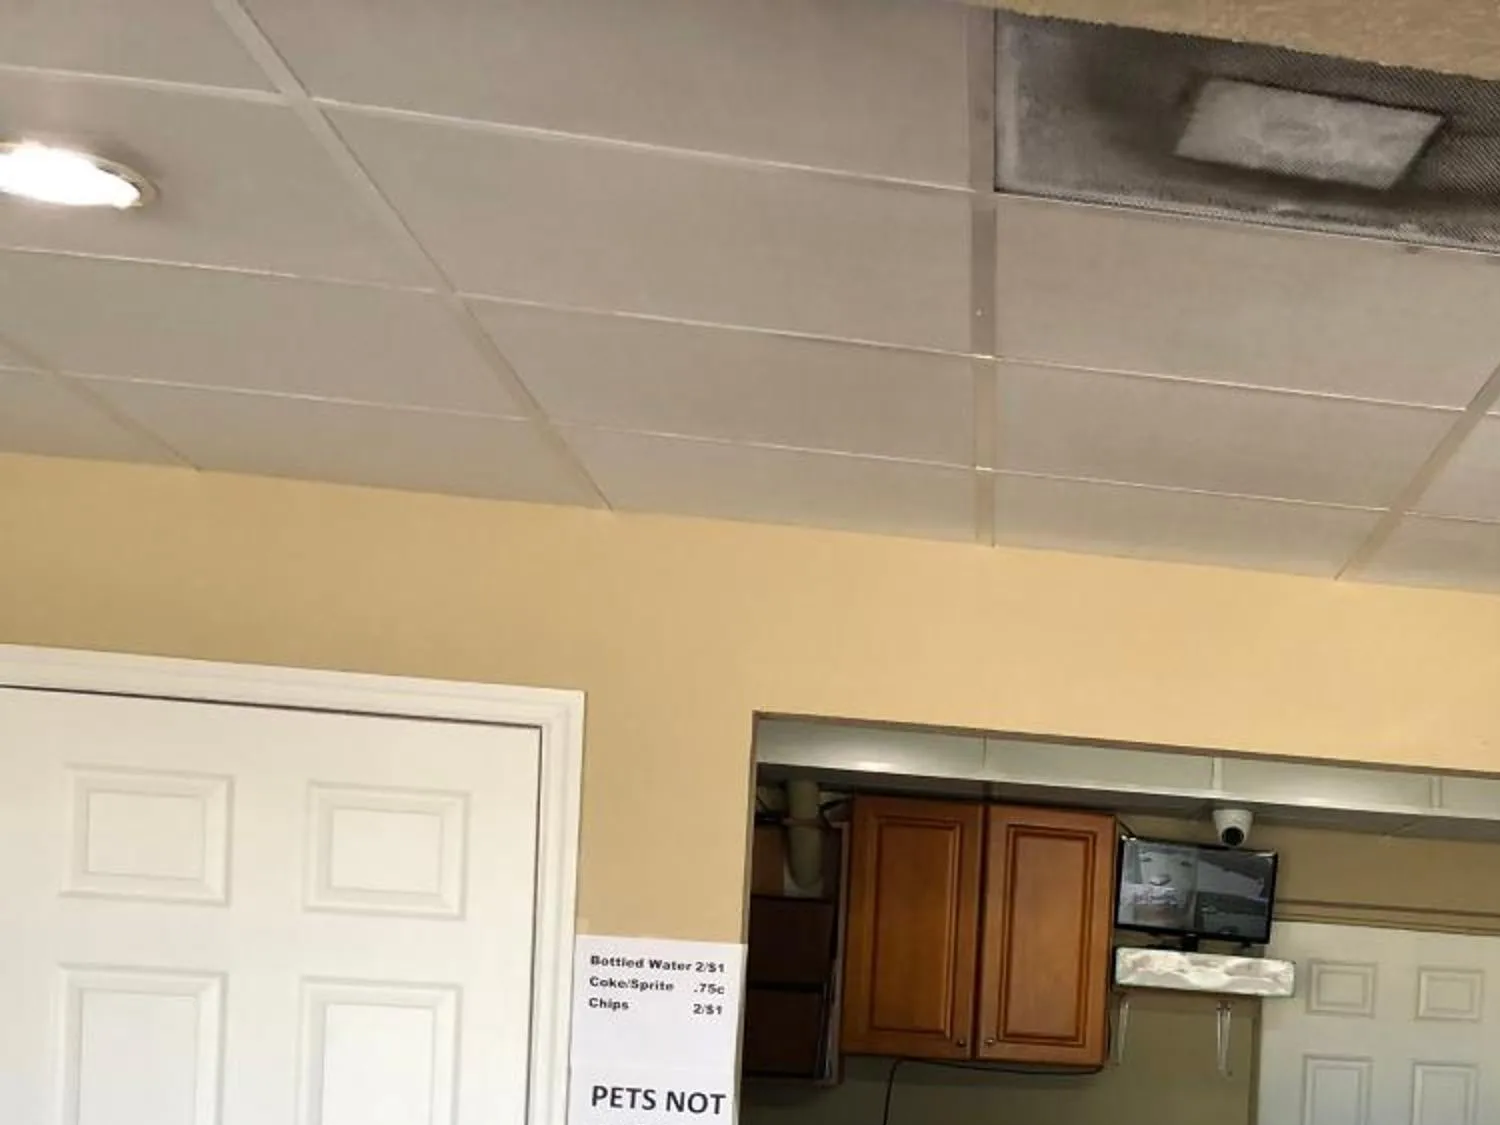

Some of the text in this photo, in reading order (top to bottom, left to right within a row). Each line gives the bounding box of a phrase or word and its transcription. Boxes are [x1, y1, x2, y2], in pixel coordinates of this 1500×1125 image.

[591, 955, 725, 974] Bottled Water 2/$1
[589, 976, 674, 993] Coke/Sprite
[589, 997, 723, 1015] Chips 2/$1
[592, 1085, 727, 1115] PETS NOT
